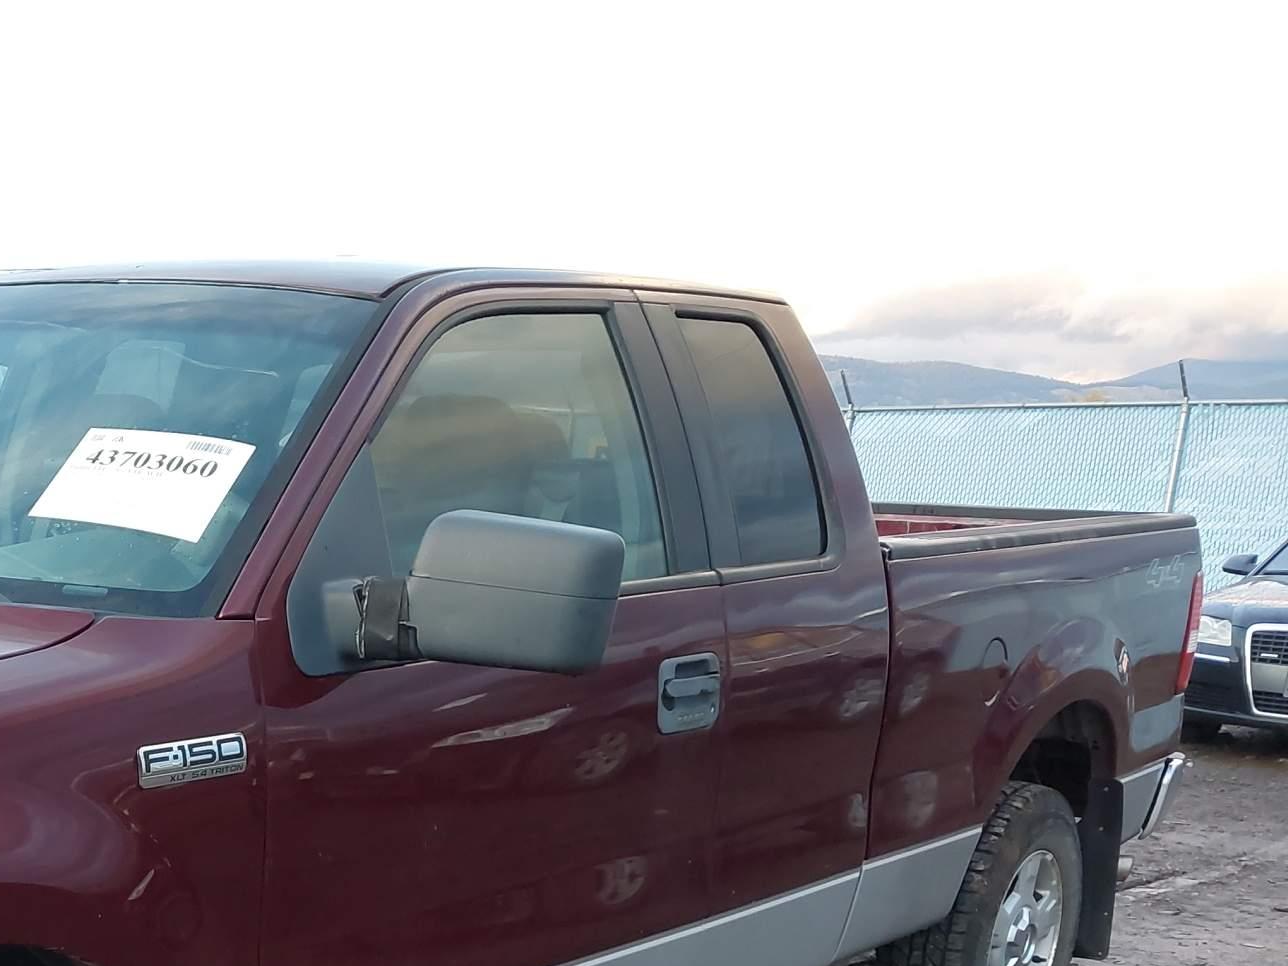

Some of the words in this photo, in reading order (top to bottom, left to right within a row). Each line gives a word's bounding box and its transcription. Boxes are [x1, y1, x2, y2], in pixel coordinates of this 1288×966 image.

[86, 448, 218, 478] 43703060
[143, 736, 244, 773] F-150
[210, 763, 244, 775] TRITON
